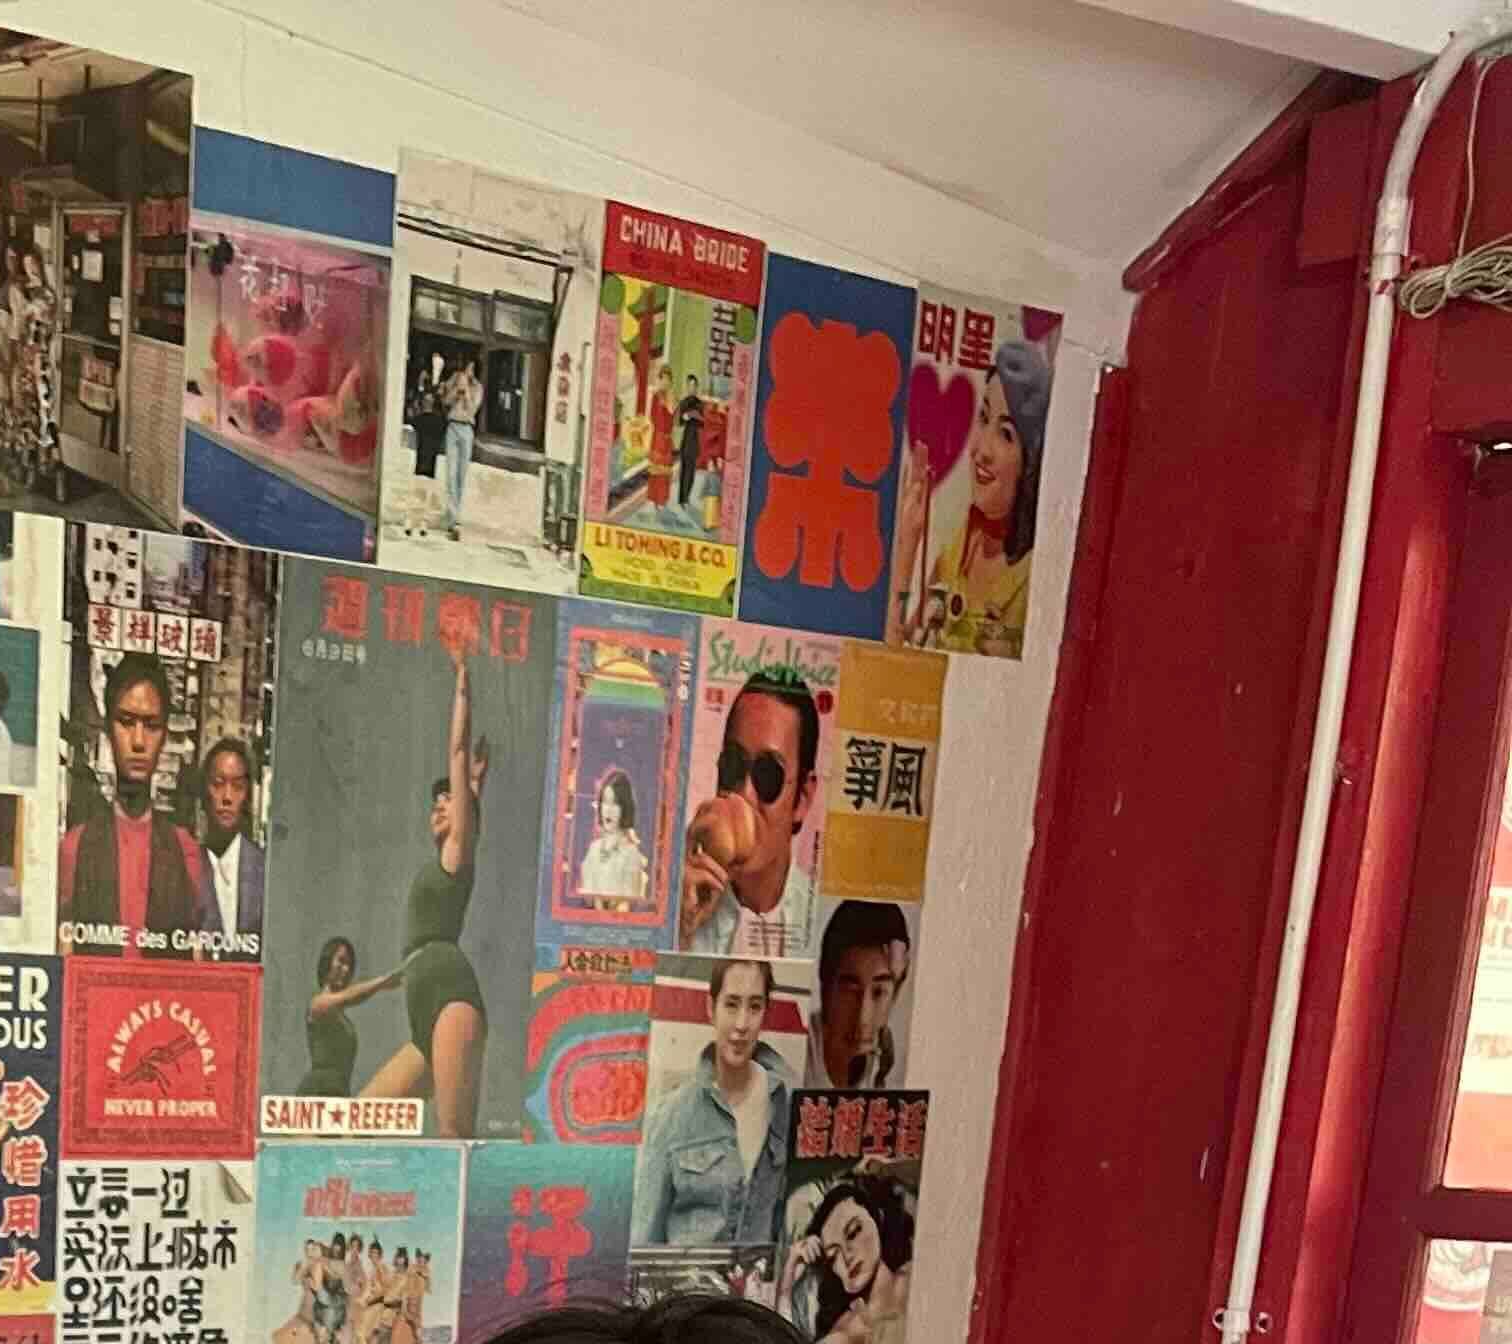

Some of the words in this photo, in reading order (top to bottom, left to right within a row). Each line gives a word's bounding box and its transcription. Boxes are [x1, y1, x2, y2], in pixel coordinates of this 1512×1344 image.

[619, 214, 684, 257] CHINA
[692, 233, 751, 273] BRIDE
[59, 921, 131, 946] COMME
[136, 927, 168, 950] des
[105, 1000, 163, 1073] ALWAYS
[169, 1002, 217, 1076] CASUAL
[104, 1098, 153, 1117] NEVER
[157, 1098, 217, 1119] PROPER
[264, 1100, 326, 1129] SAINT
[348, 1101, 419, 1132] REEFER
